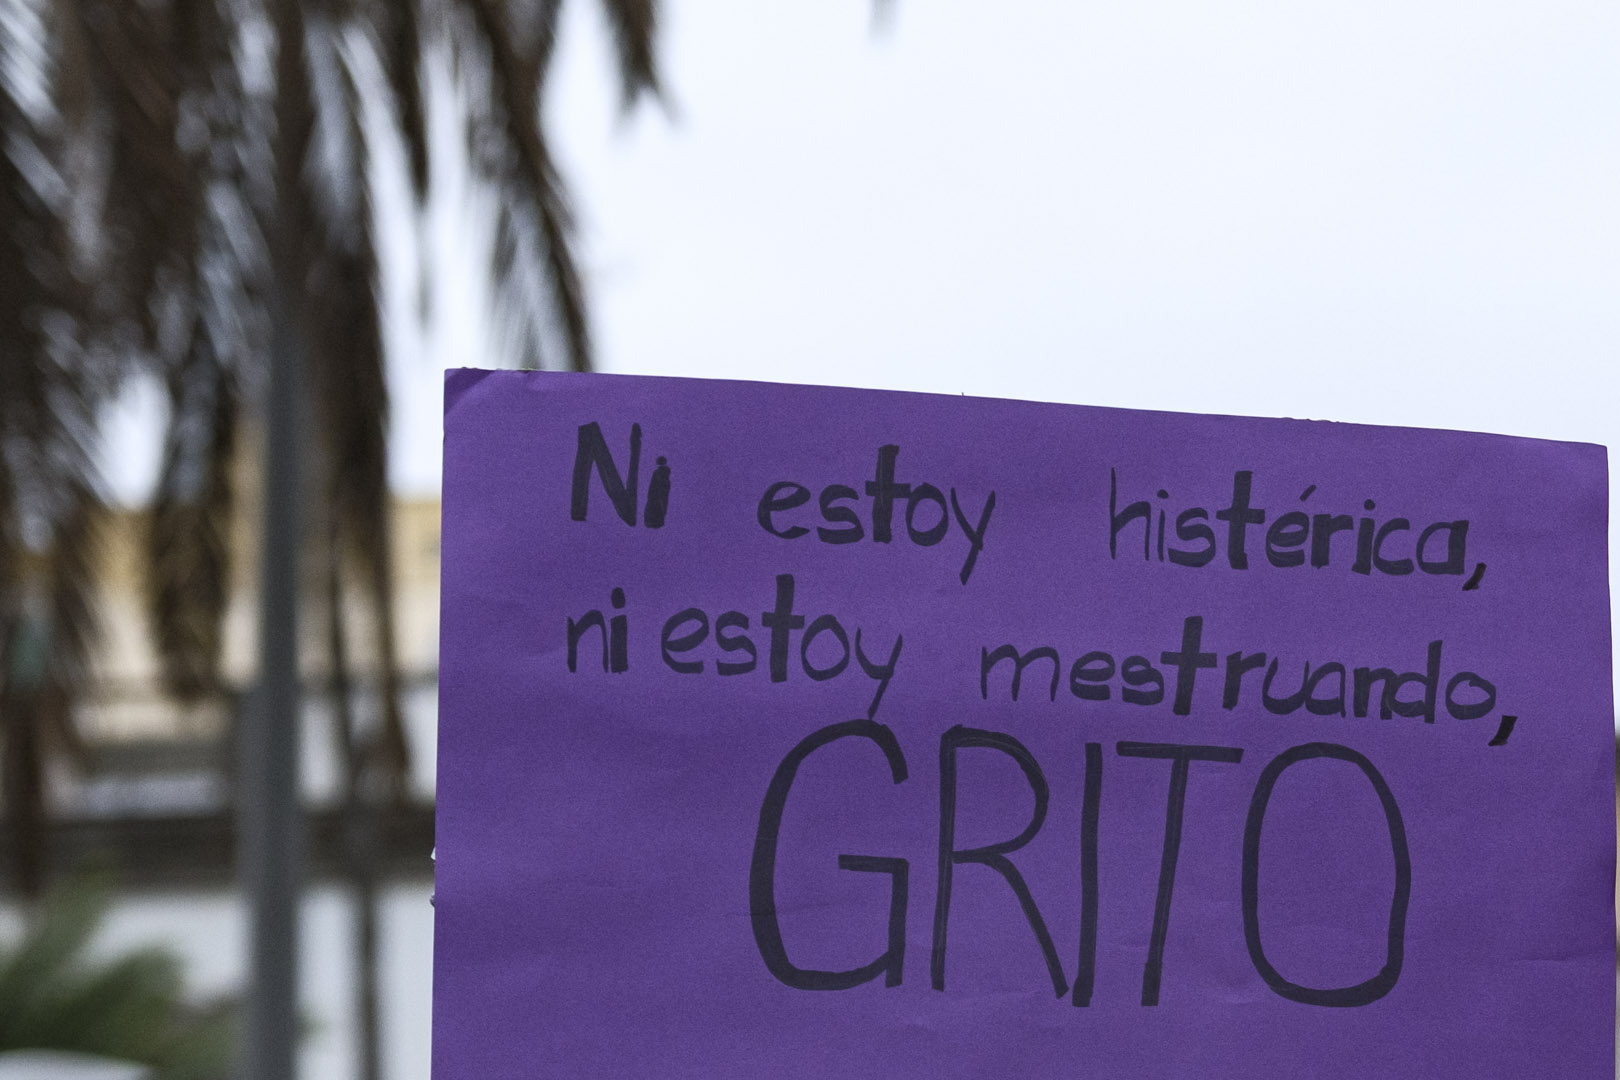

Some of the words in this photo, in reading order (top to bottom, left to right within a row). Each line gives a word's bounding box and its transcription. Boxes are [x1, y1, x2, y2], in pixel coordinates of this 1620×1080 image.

[569, 421, 672, 530] Ni
[756, 443, 997, 586] estoy
[1109, 467, 1487, 592] histérica,
[566, 586, 629, 675] ni
[660, 573, 906, 722] estoy
[980, 615, 1519, 747] mestruando,
[748, 718, 1412, 1008] GRITO
